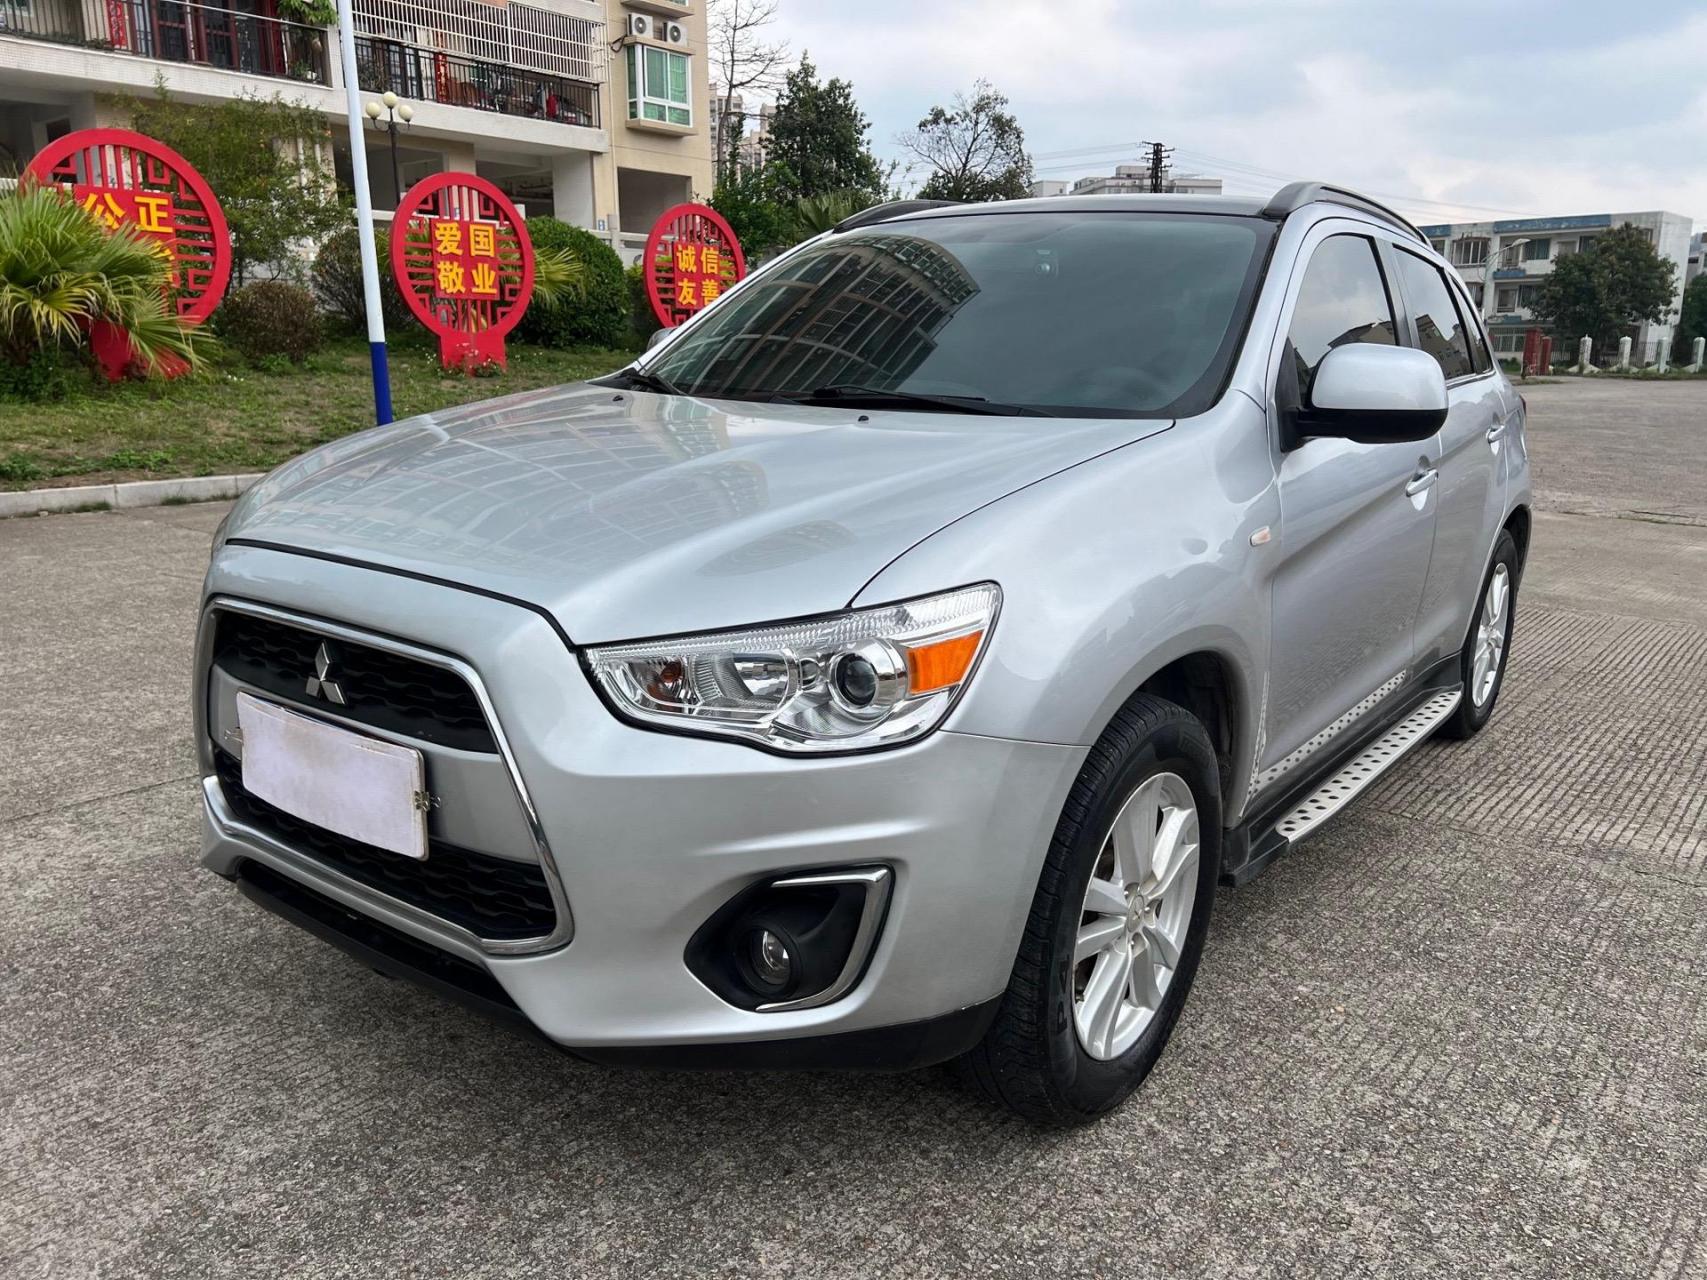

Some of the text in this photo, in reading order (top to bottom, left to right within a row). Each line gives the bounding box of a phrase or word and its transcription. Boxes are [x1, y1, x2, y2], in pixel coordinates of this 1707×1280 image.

[83, 193, 173, 233] 公正
[435, 222, 495, 257] 爱国
[676, 244, 720, 274] 诚信
[437, 261, 498, 294] 敬业
[677, 278, 720, 305] 友善
